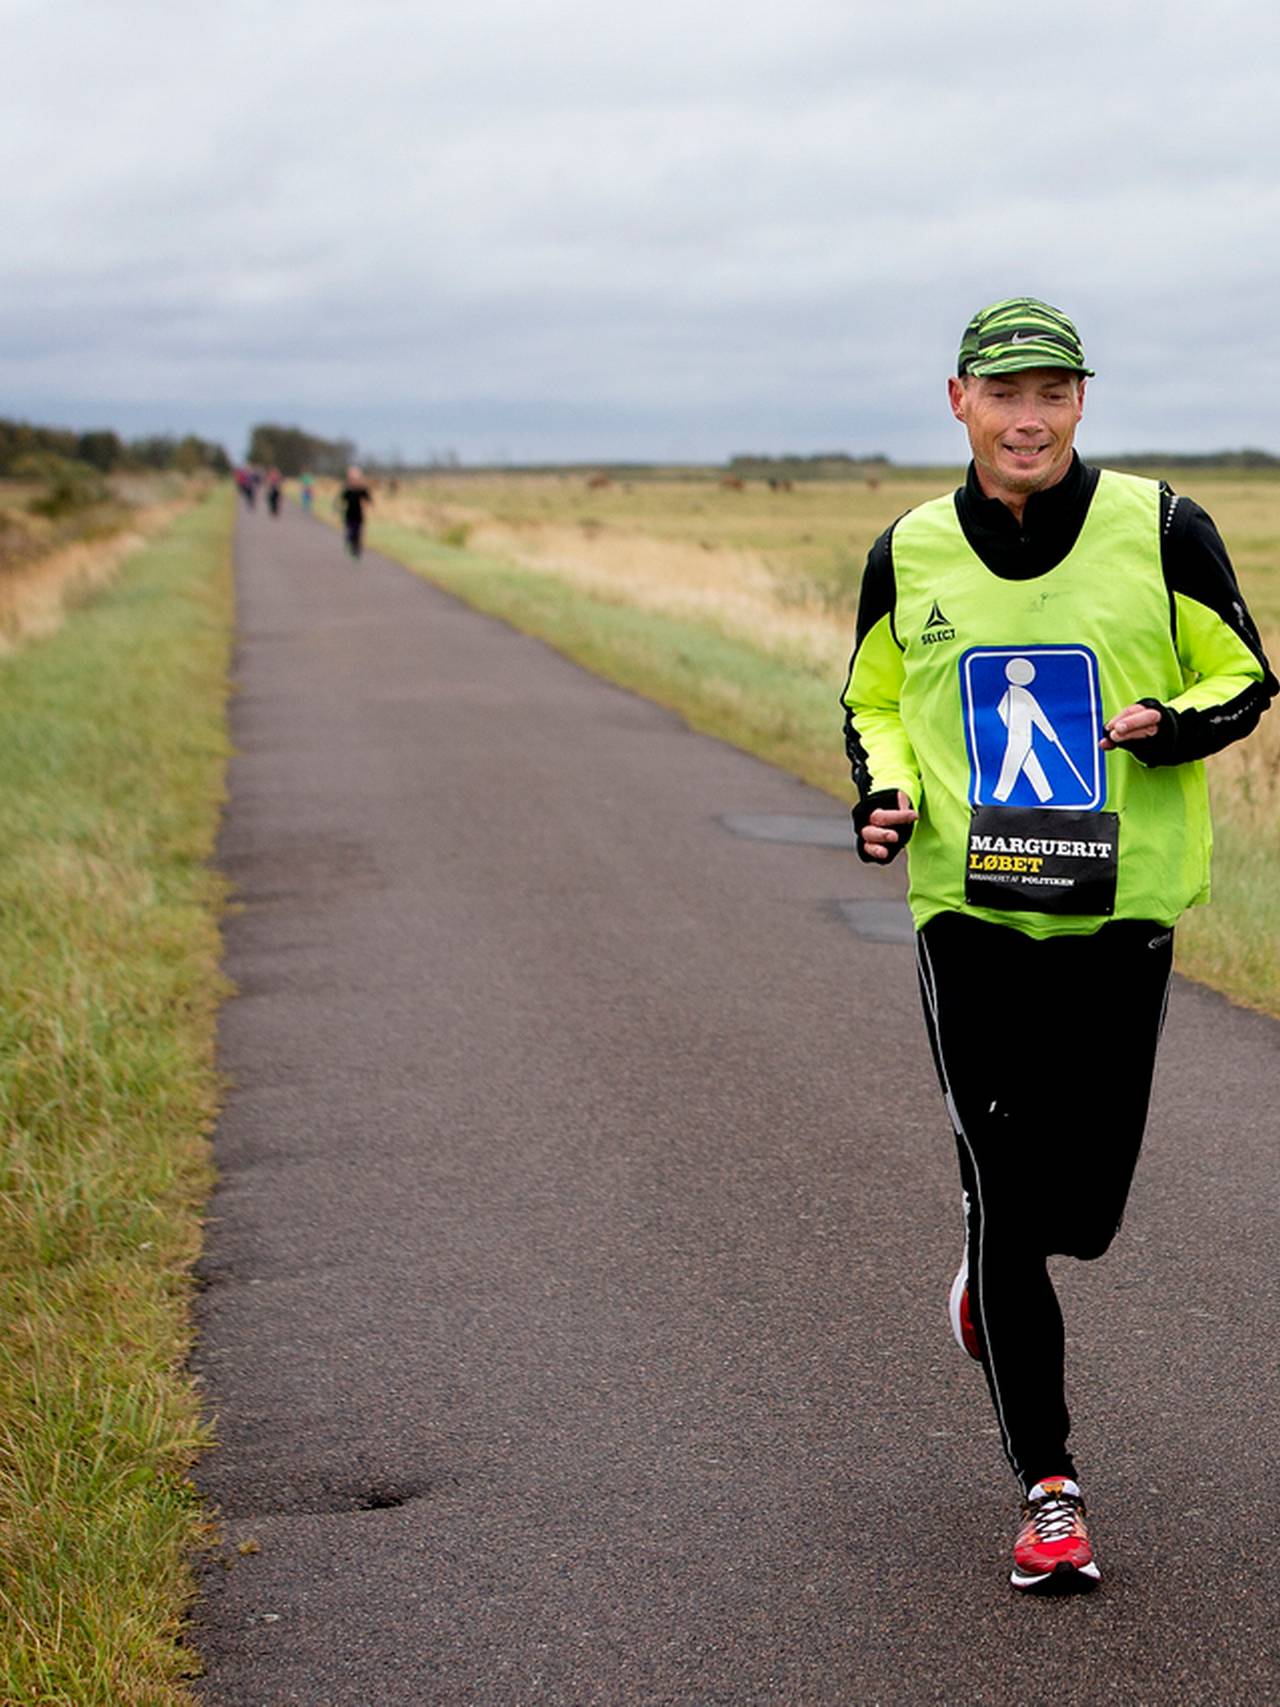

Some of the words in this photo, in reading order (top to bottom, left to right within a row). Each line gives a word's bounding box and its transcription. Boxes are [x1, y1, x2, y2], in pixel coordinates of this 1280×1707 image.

[921, 629, 955, 645] SELECT
[970, 835, 1112, 858] MARGUERIT
[969, 854, 1043, 873] LØBET
[1021, 875, 1075, 886] POLITIKEN
